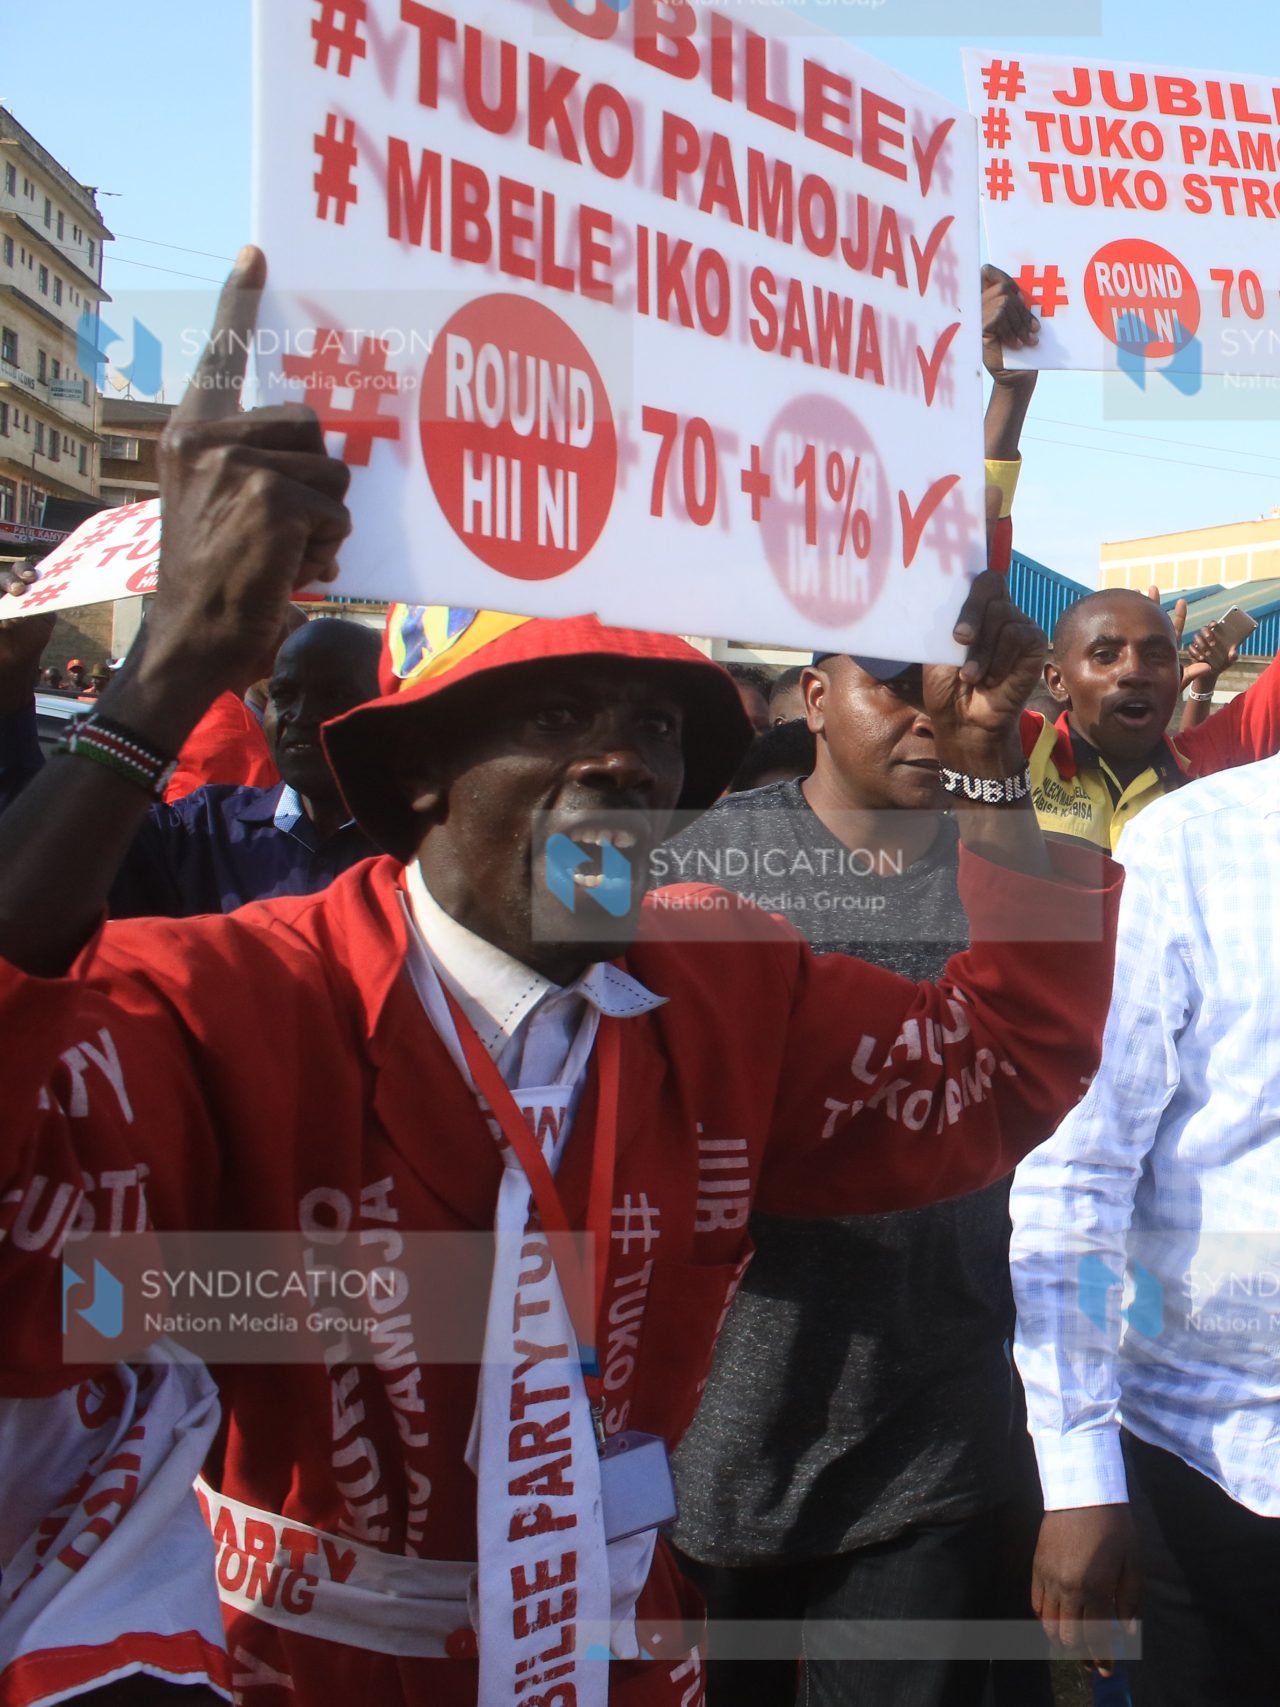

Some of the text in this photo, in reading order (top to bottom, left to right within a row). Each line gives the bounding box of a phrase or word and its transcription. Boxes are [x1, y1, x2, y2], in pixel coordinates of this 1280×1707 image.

[981, 60, 1026, 101] #
[400, 0, 634, 180] TUKO
[662, 110, 908, 289] PAMOJA
[982, 107, 1011, 149] #
[1025, 111, 1164, 161] TUKO
[985, 158, 1015, 201] #
[1028, 161, 1167, 211] TUKO
[314, 112, 885, 386] # MBELE IKO SAWA
[1094, 261, 1183, 299] ROUND
[1111, 307, 1183, 344] HII NI
[1210, 268, 1264, 320] 70
[446, 333, 595, 449] ROUND
[463, 448, 578, 551] HII NI
[642, 405, 871, 560] 70 + 1%
[97, 542, 161, 567] TU
[602, 1258, 654, 1391] TUKO
[507, 1338, 578, 1543] PARTY
[217, 1545, 319, 1615] ONG
